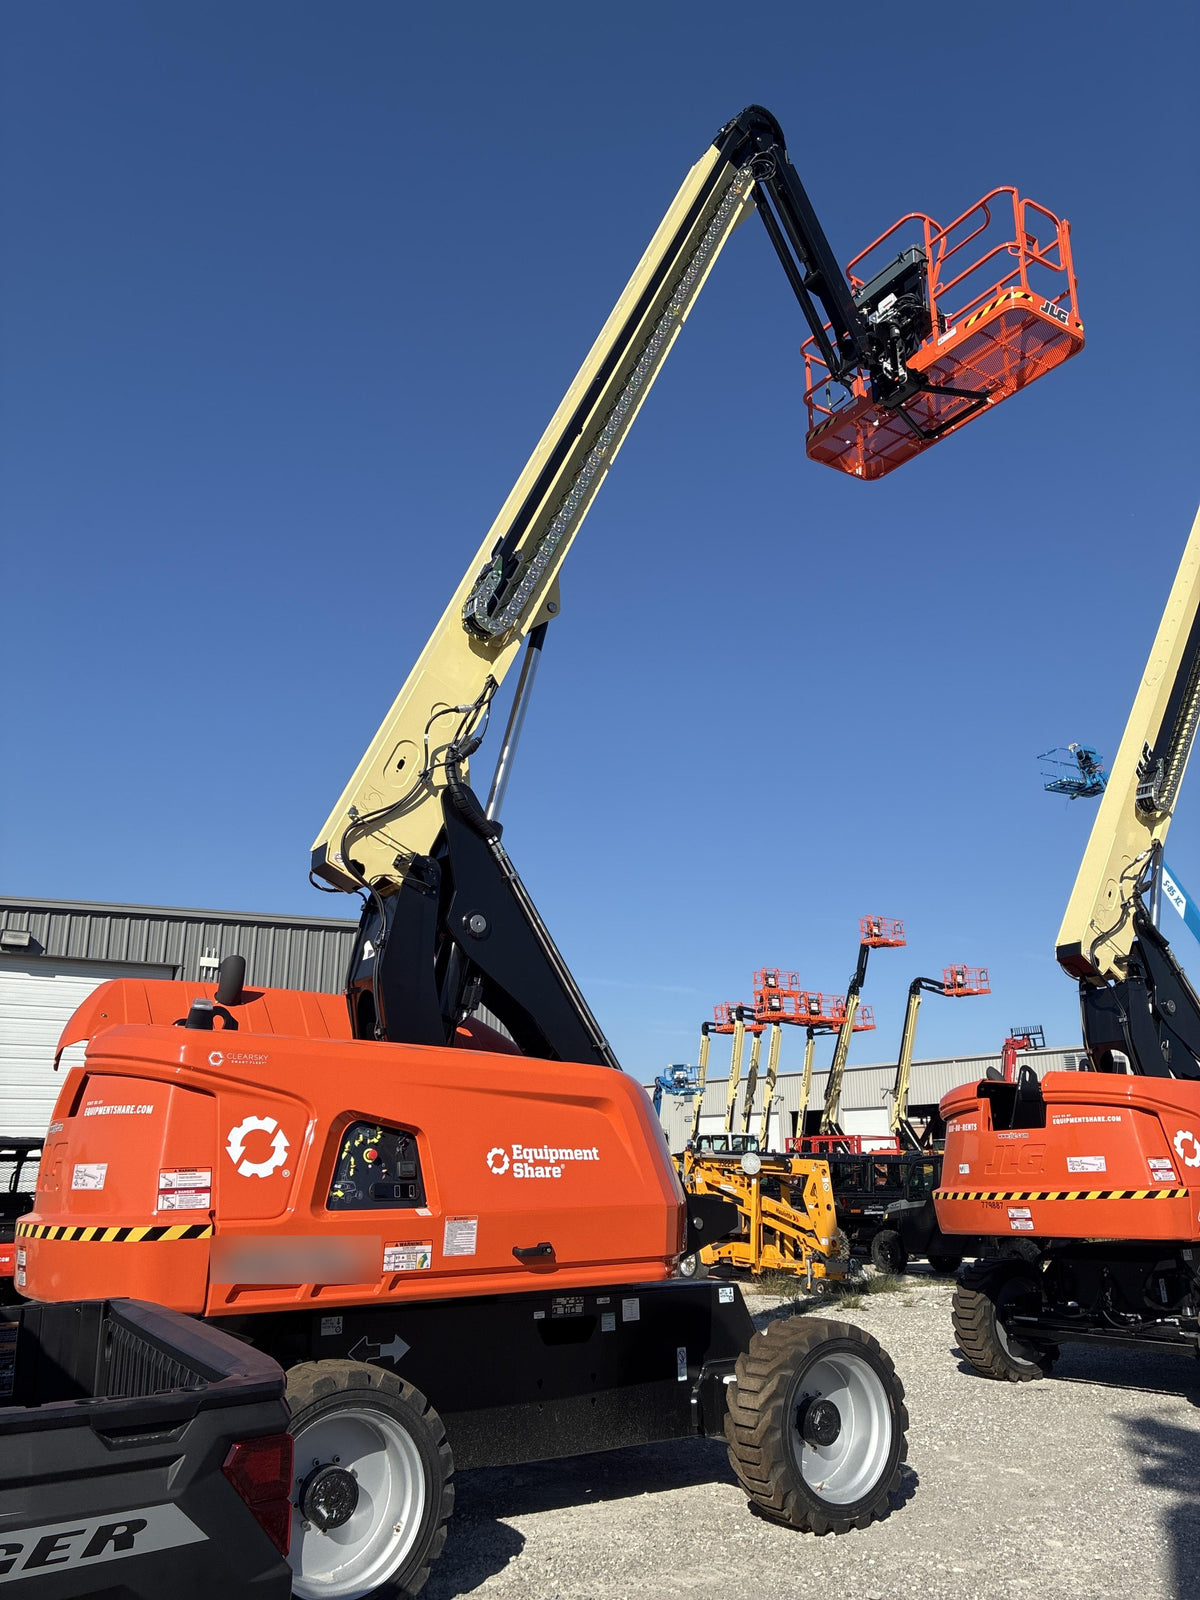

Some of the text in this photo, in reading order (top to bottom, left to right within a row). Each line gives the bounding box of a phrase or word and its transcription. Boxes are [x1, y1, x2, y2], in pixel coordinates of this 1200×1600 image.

[1040, 301, 1068, 324] JLG
[1174, 896, 1183, 907] XC
[226, 1053, 268, 1061] CLEARSKY
[84, 1105, 154, 1117] EQUIPMENTSHARE.COM
[1052, 1115, 1122, 1125] EQUIPMENTSHARE.COM
[511, 1144, 600, 1163] Equipment
[512, 1162, 562, 1178] Share
